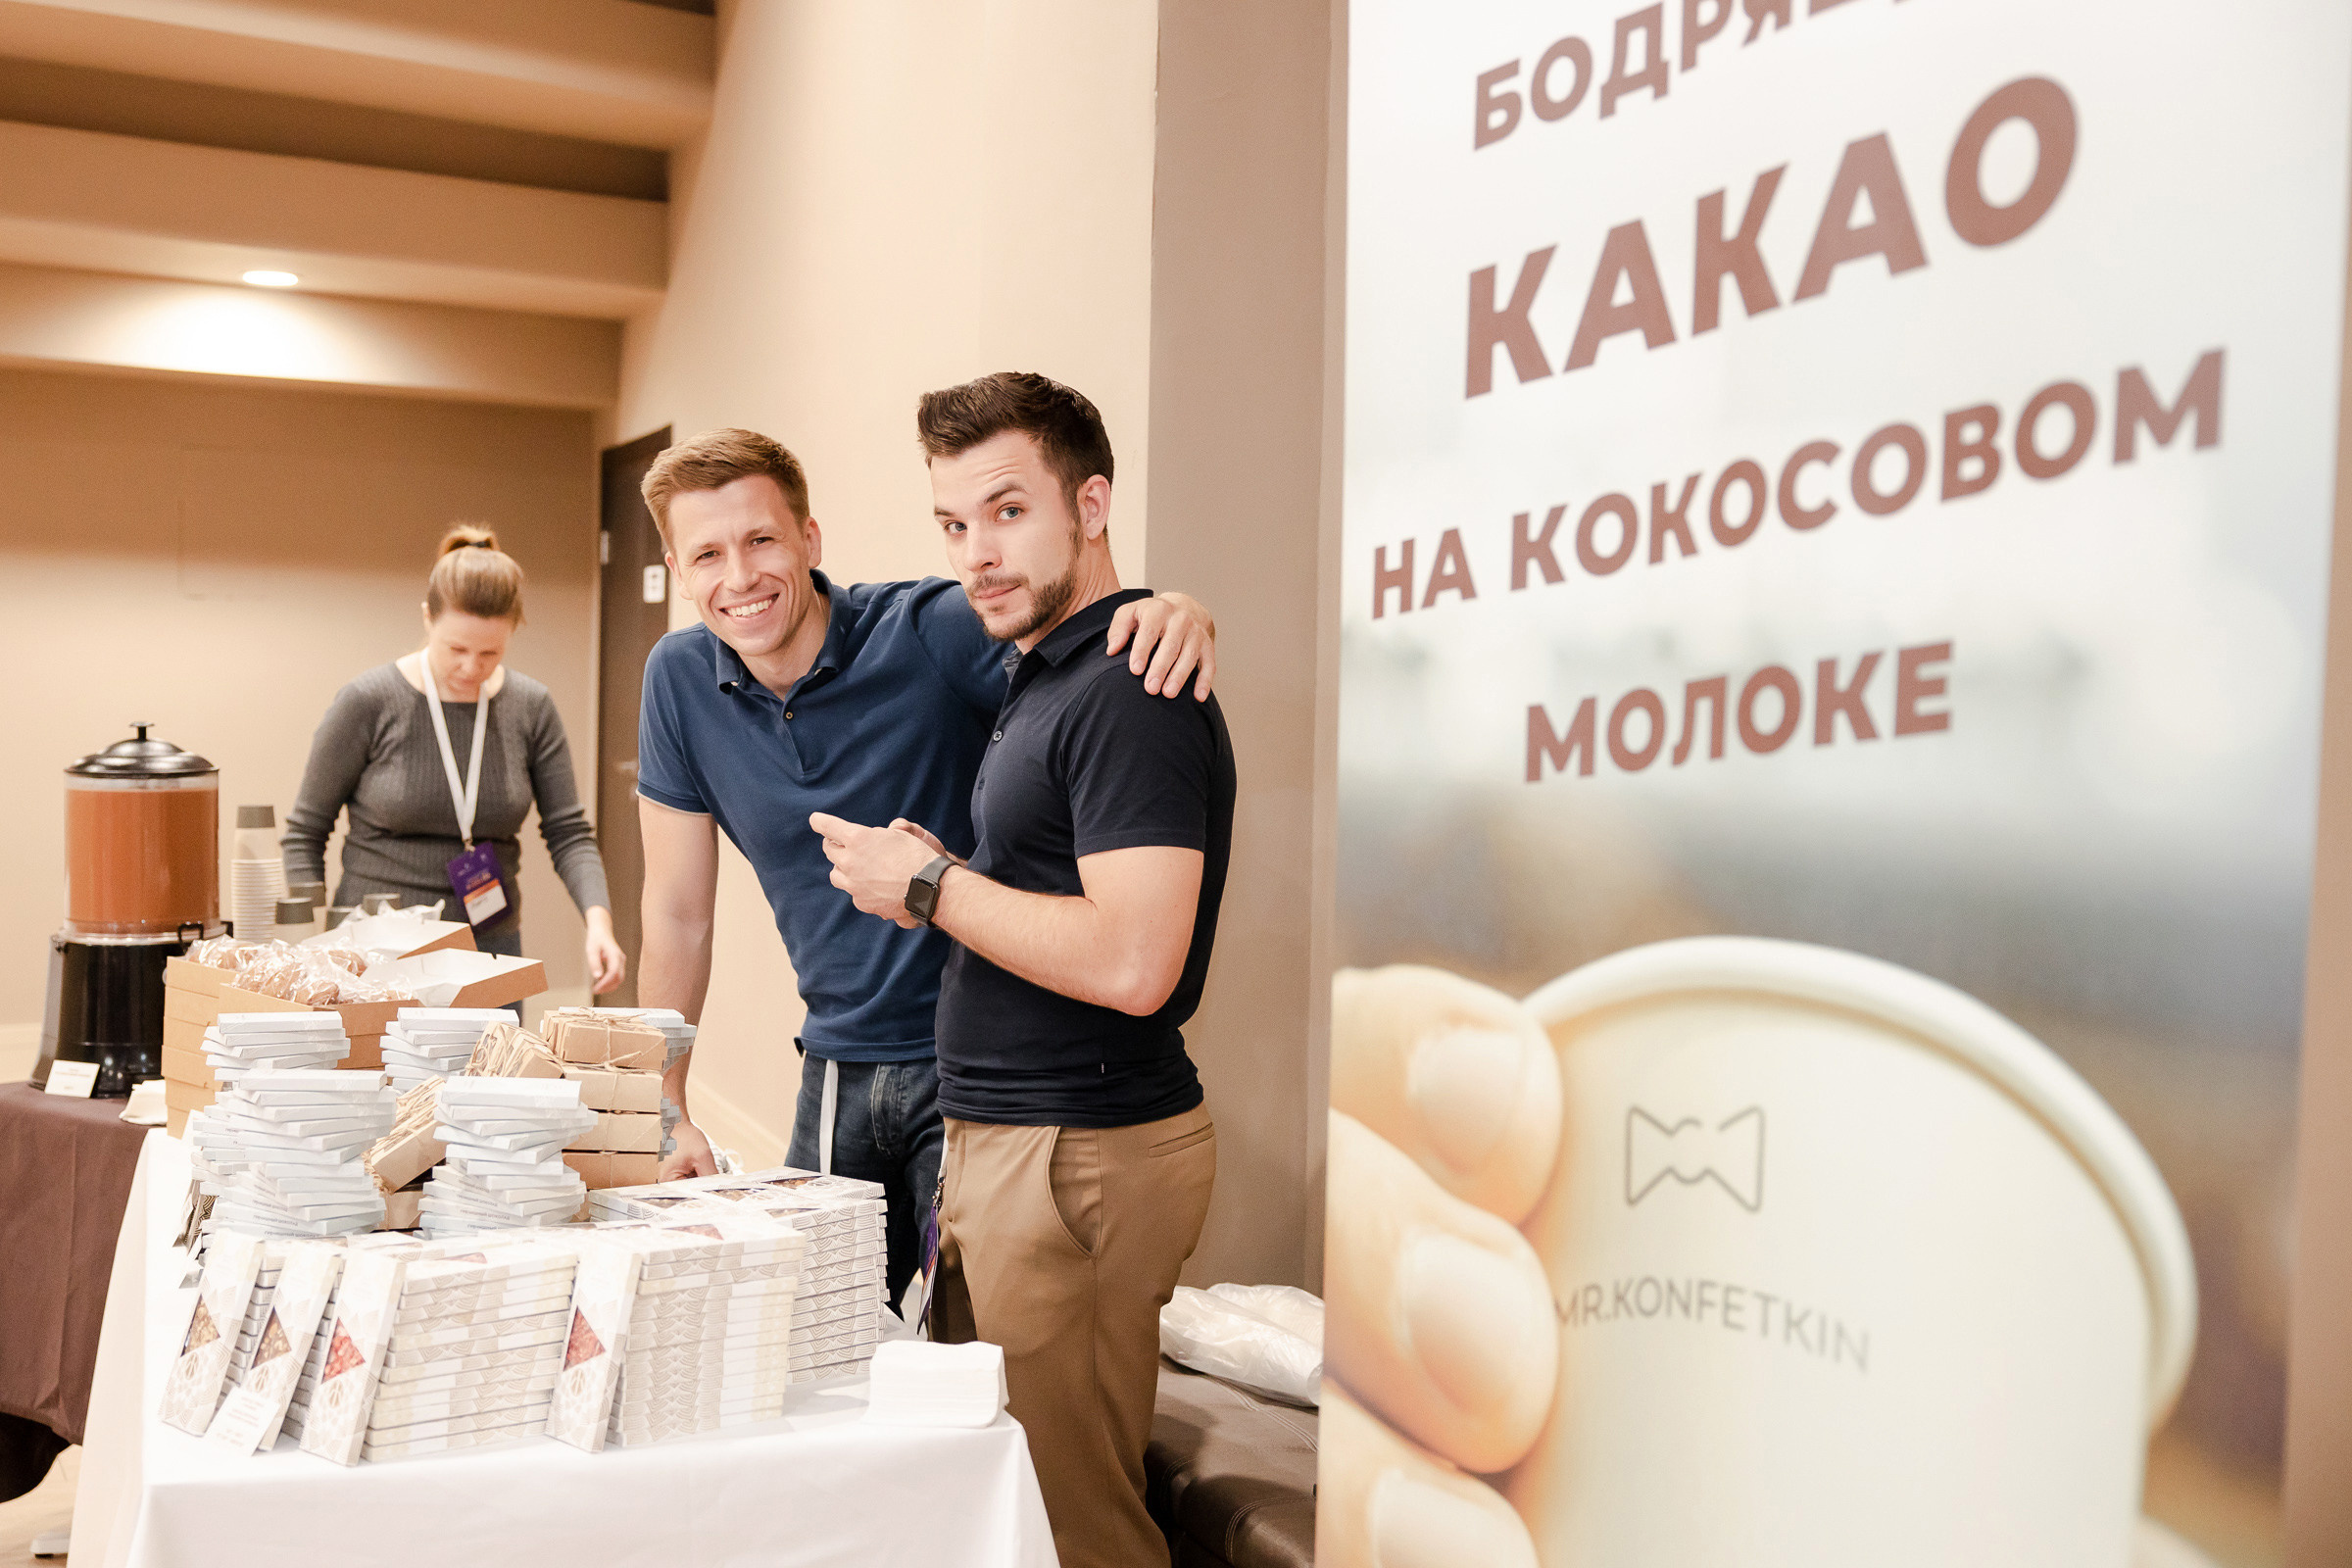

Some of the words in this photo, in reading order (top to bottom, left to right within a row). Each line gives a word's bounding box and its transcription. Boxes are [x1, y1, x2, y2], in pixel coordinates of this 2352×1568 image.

[1473, 0, 1913, 151] БОДРЯ
[1465, 74, 2079, 399] КАКАО
[1372, 527, 1478, 619] НА
[1509, 347, 2227, 591] КОКОСОВОМ
[1526, 640, 1954, 784] МОЛОКЕ
[1553, 1276, 1869, 1374] MR.KONFETKIN
